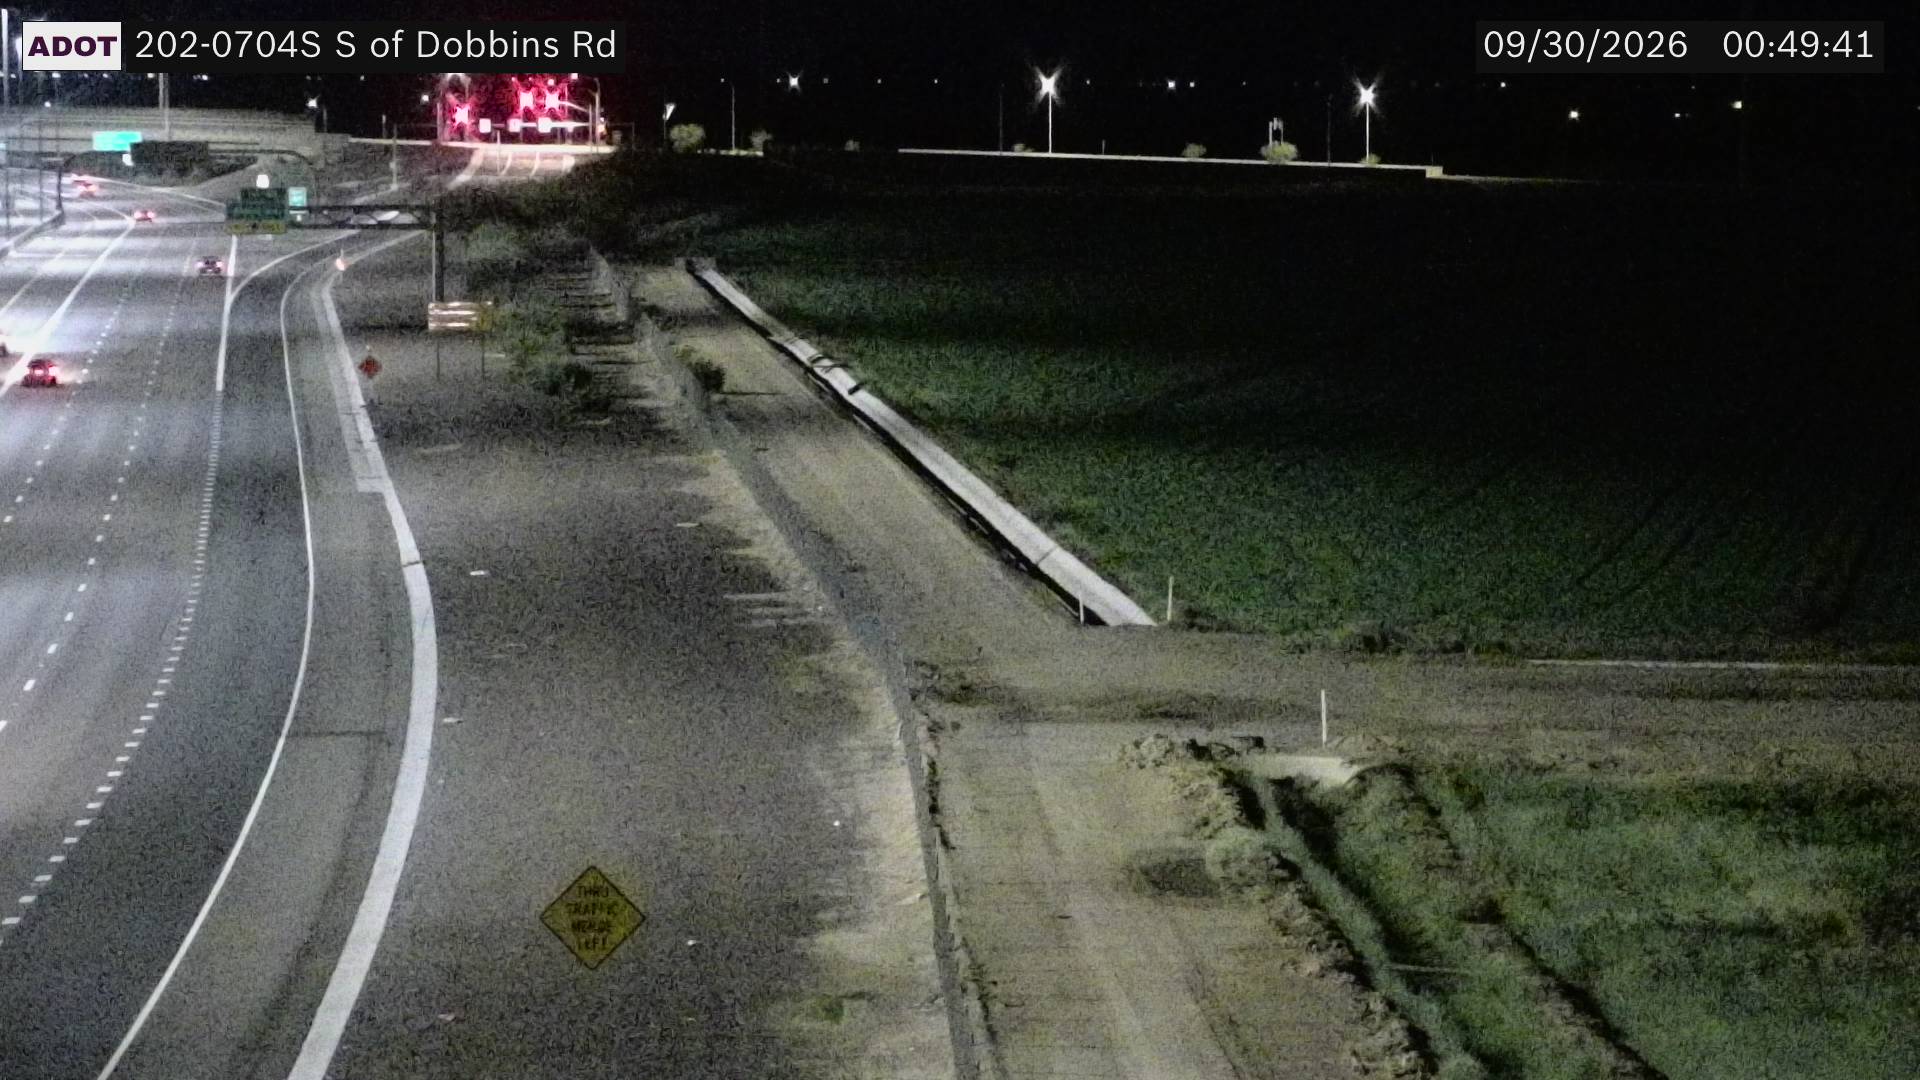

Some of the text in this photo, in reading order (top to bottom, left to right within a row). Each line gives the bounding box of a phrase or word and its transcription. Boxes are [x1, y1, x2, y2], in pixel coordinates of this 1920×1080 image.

[577, 886, 609, 898] THRU
[566, 902, 619, 916] TRAFFIC
[571, 920, 613, 933] MERGE
[577, 936, 608, 951] LEFT
